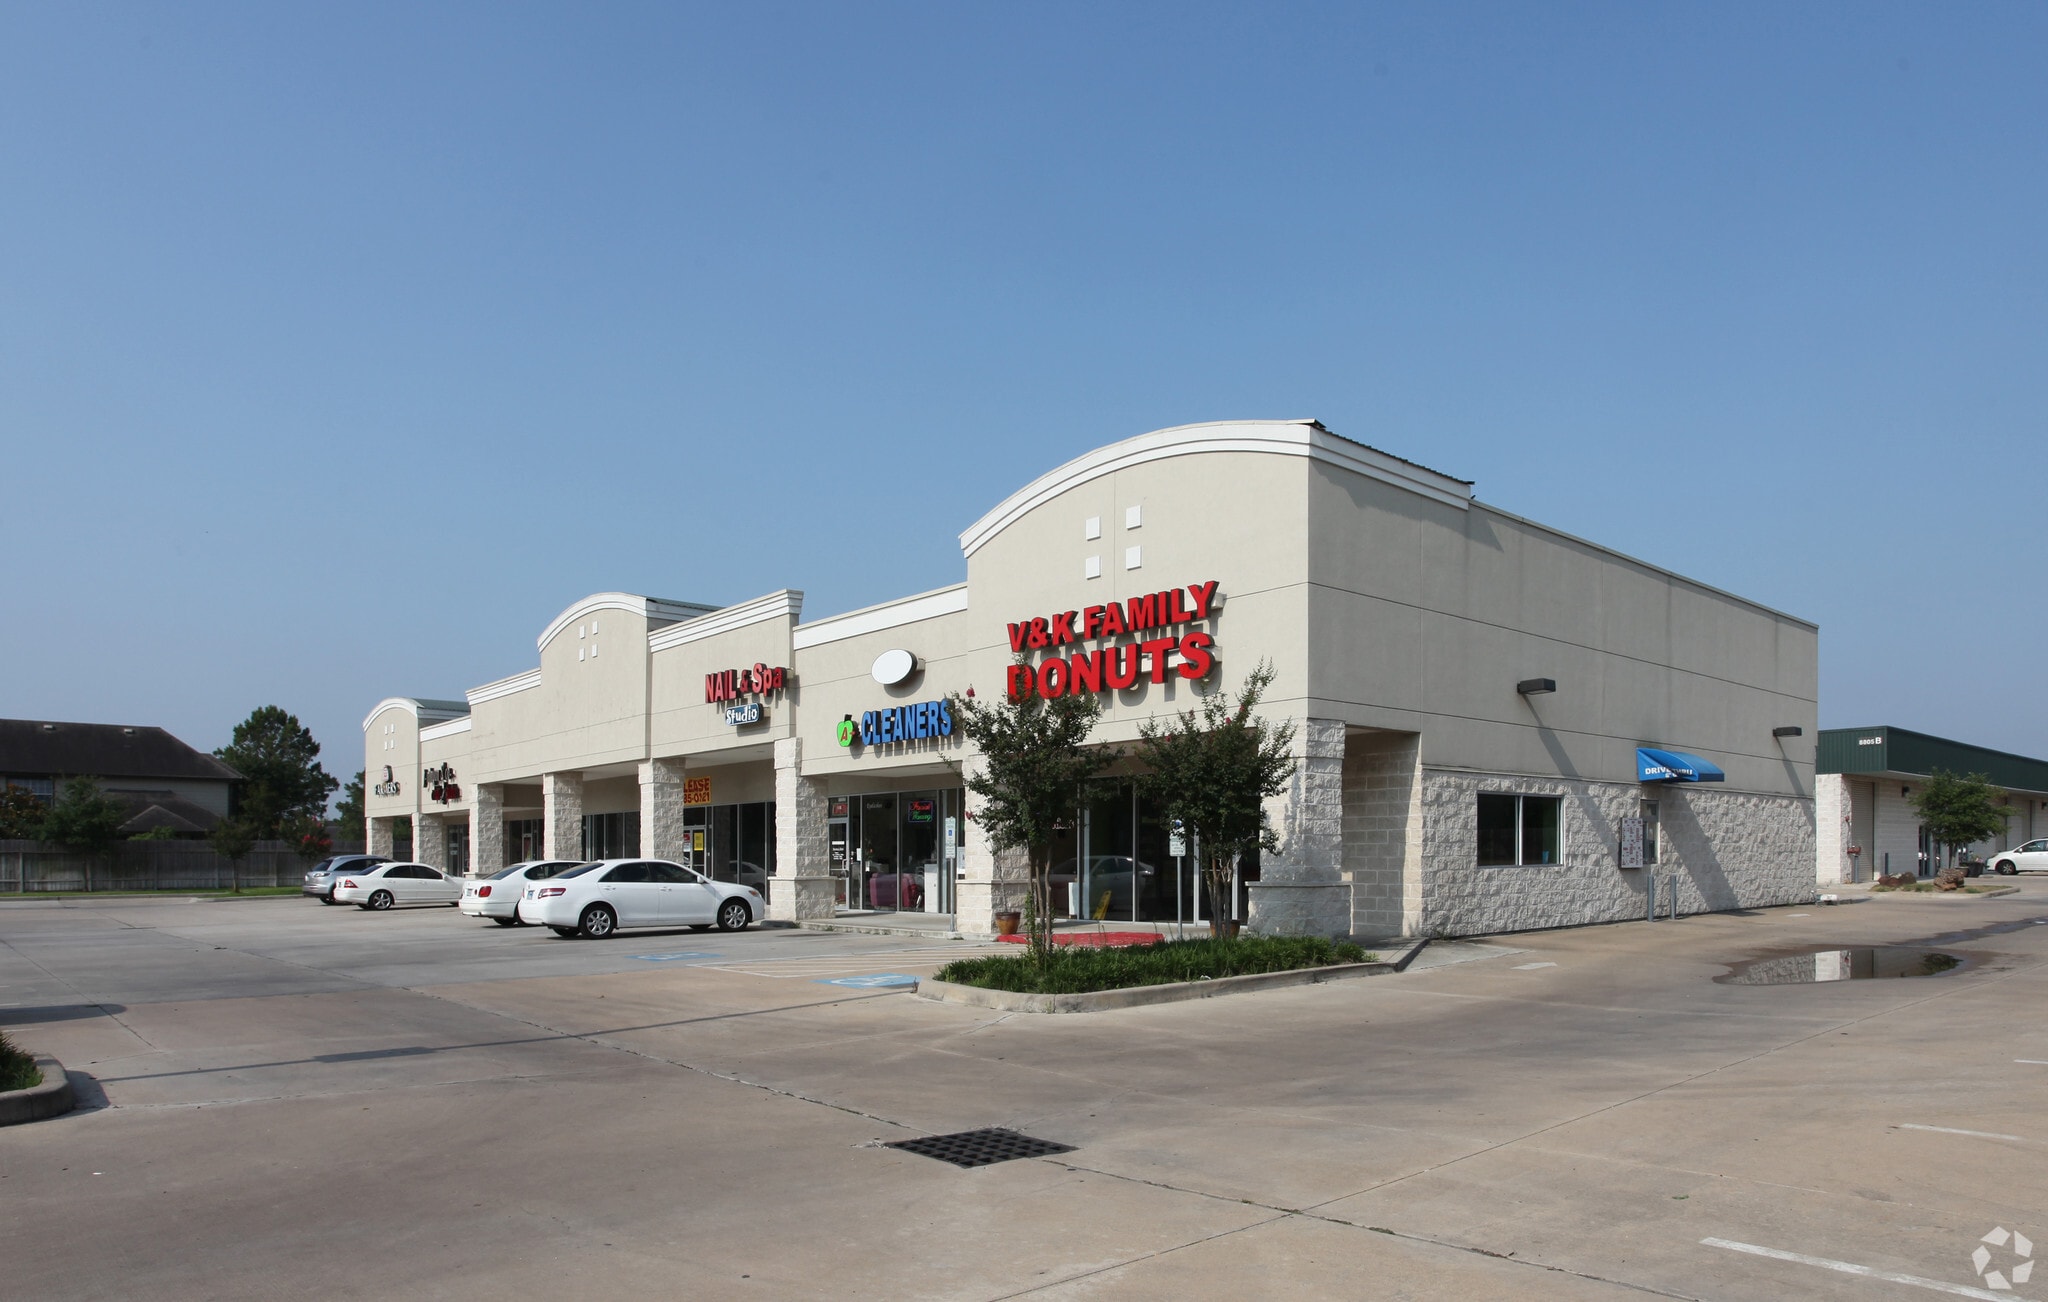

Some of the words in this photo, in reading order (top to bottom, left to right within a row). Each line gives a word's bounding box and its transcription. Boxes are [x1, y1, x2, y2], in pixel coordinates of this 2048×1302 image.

[1007, 610, 1078, 653] V&K
[1084, 580, 1219, 640] FAMILY
[705, 668, 737, 704] NAIL
[740, 669, 753, 693] &
[752, 662, 787, 698] Spa
[1007, 631, 1215, 705] DONUTS
[726, 704, 758, 725] Studio
[861, 698, 955, 747] CLEANERS
